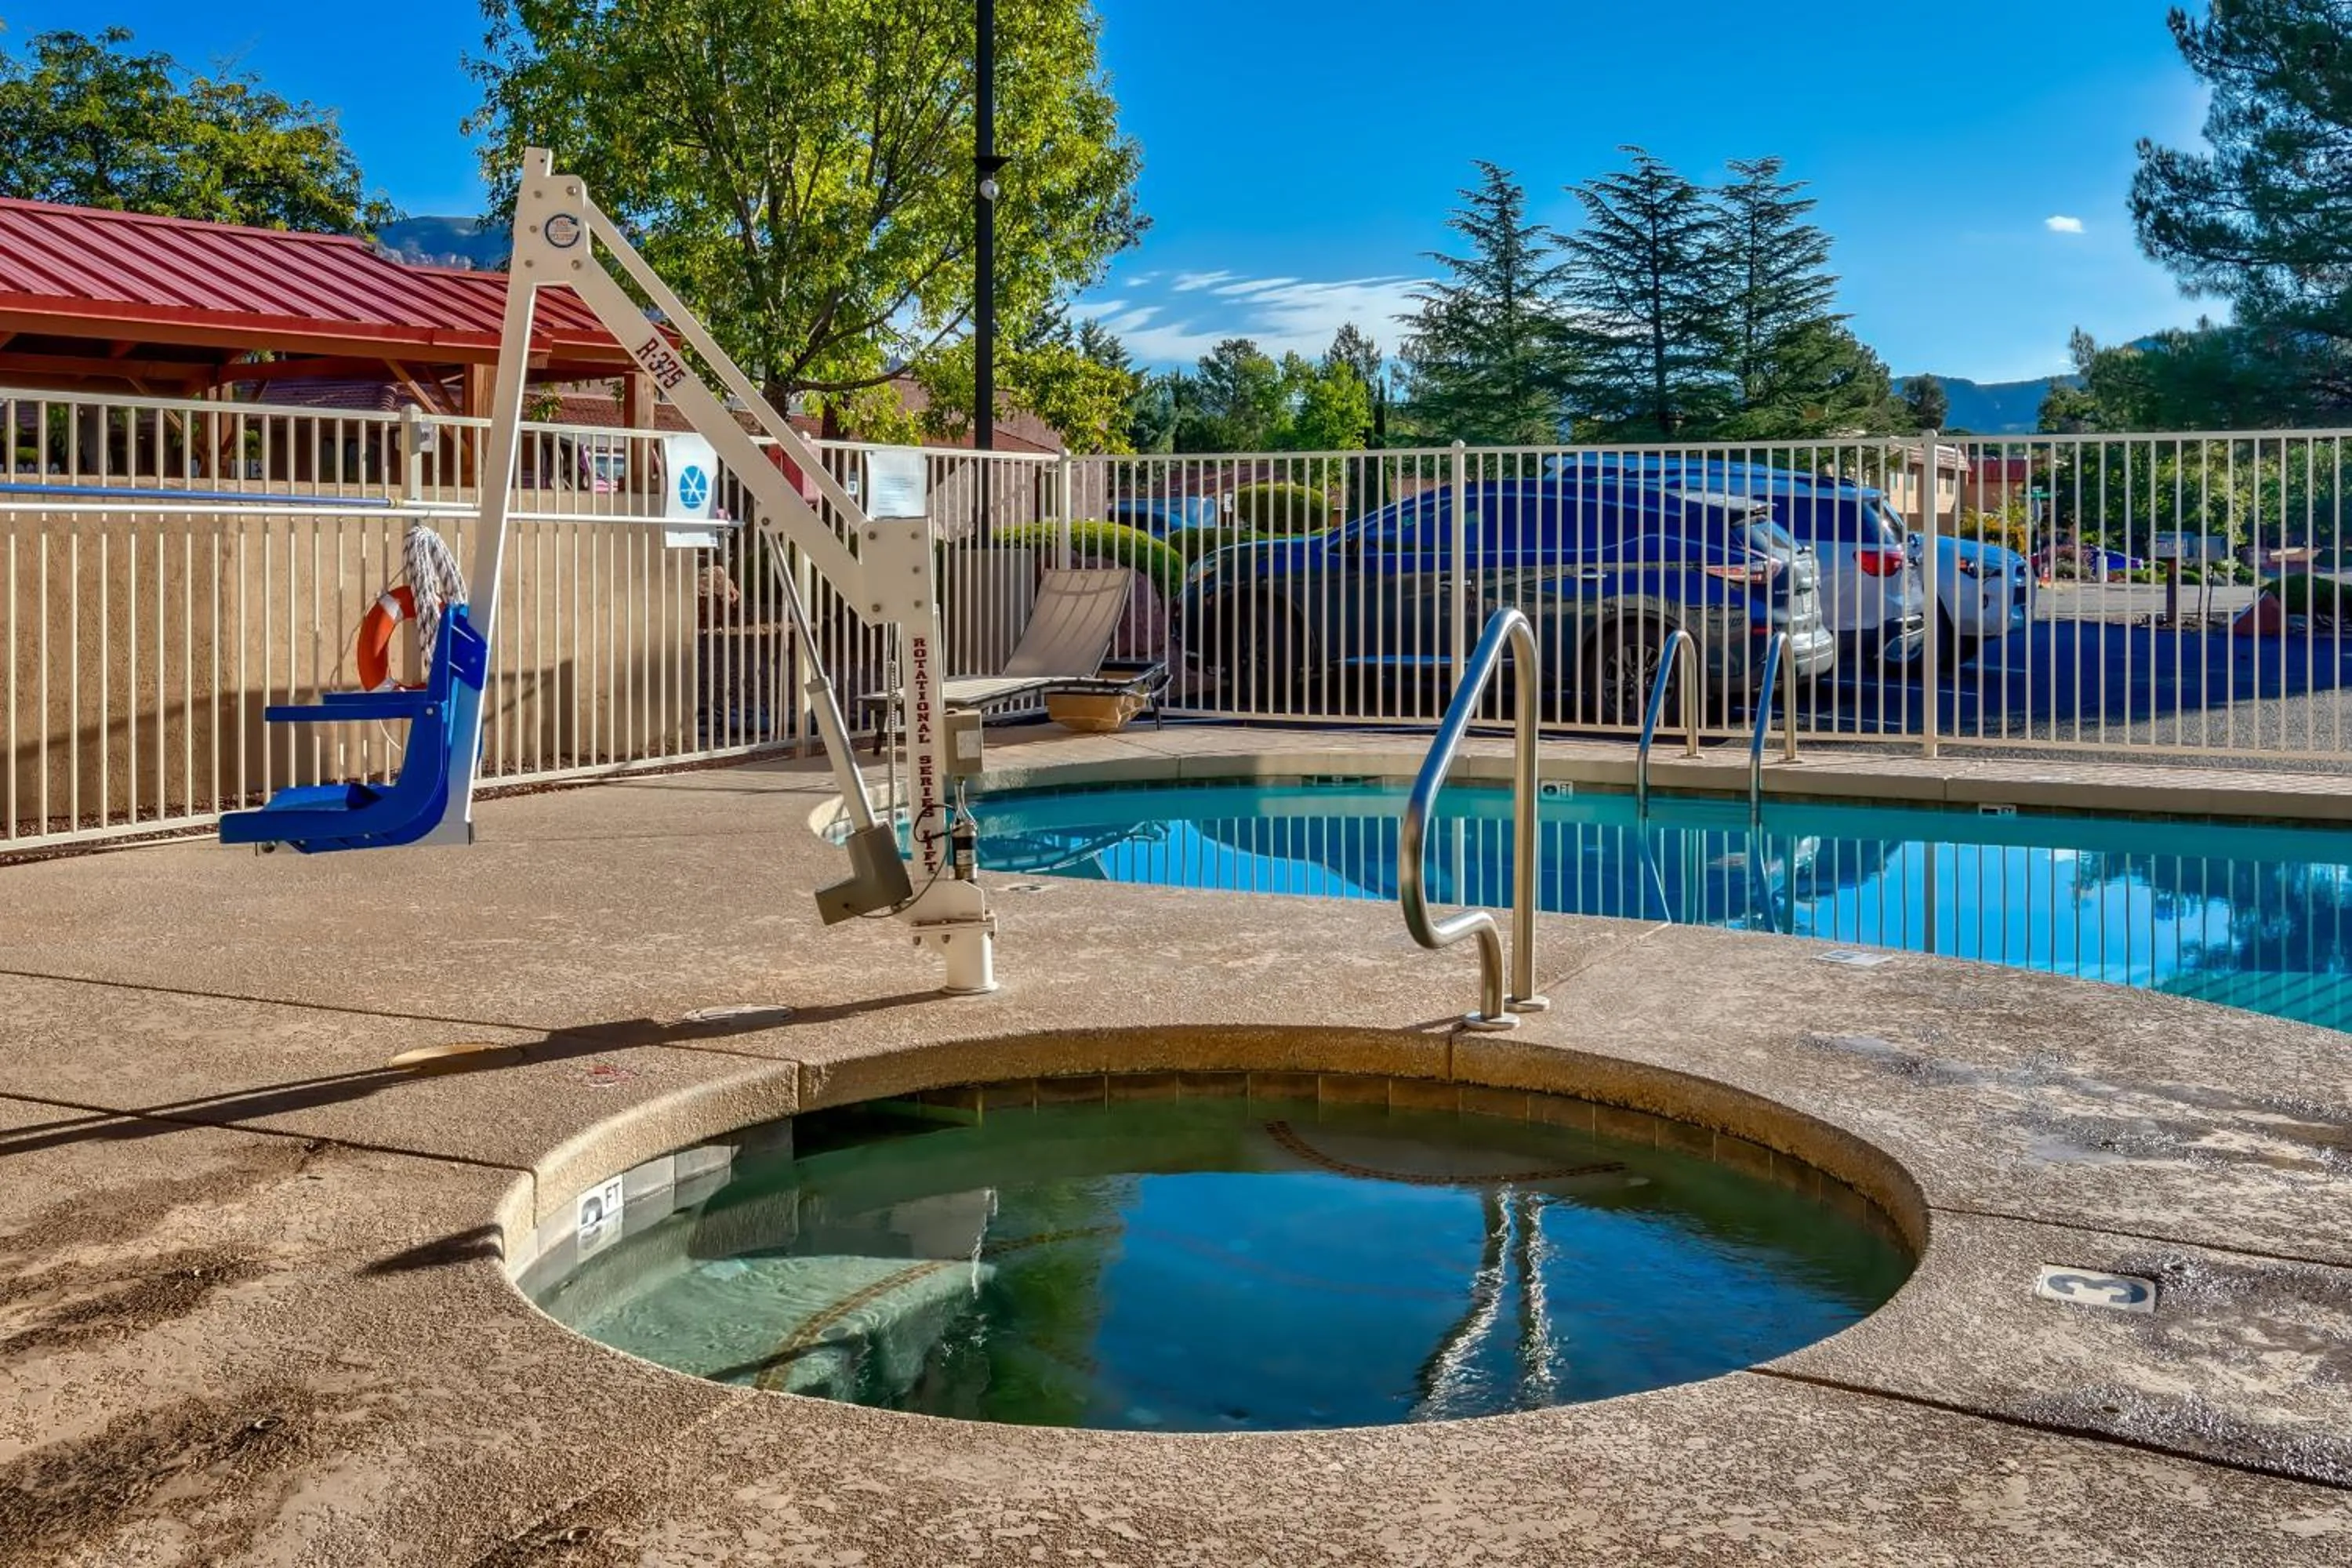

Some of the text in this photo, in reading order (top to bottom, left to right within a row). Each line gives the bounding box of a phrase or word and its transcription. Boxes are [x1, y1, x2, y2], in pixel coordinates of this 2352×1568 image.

[913, 637, 931, 744] ROTATIONAL
[918, 755, 935, 818] SERIES
[605, 1181, 620, 1208] FT
[2048, 1274, 2148, 1304] 3
